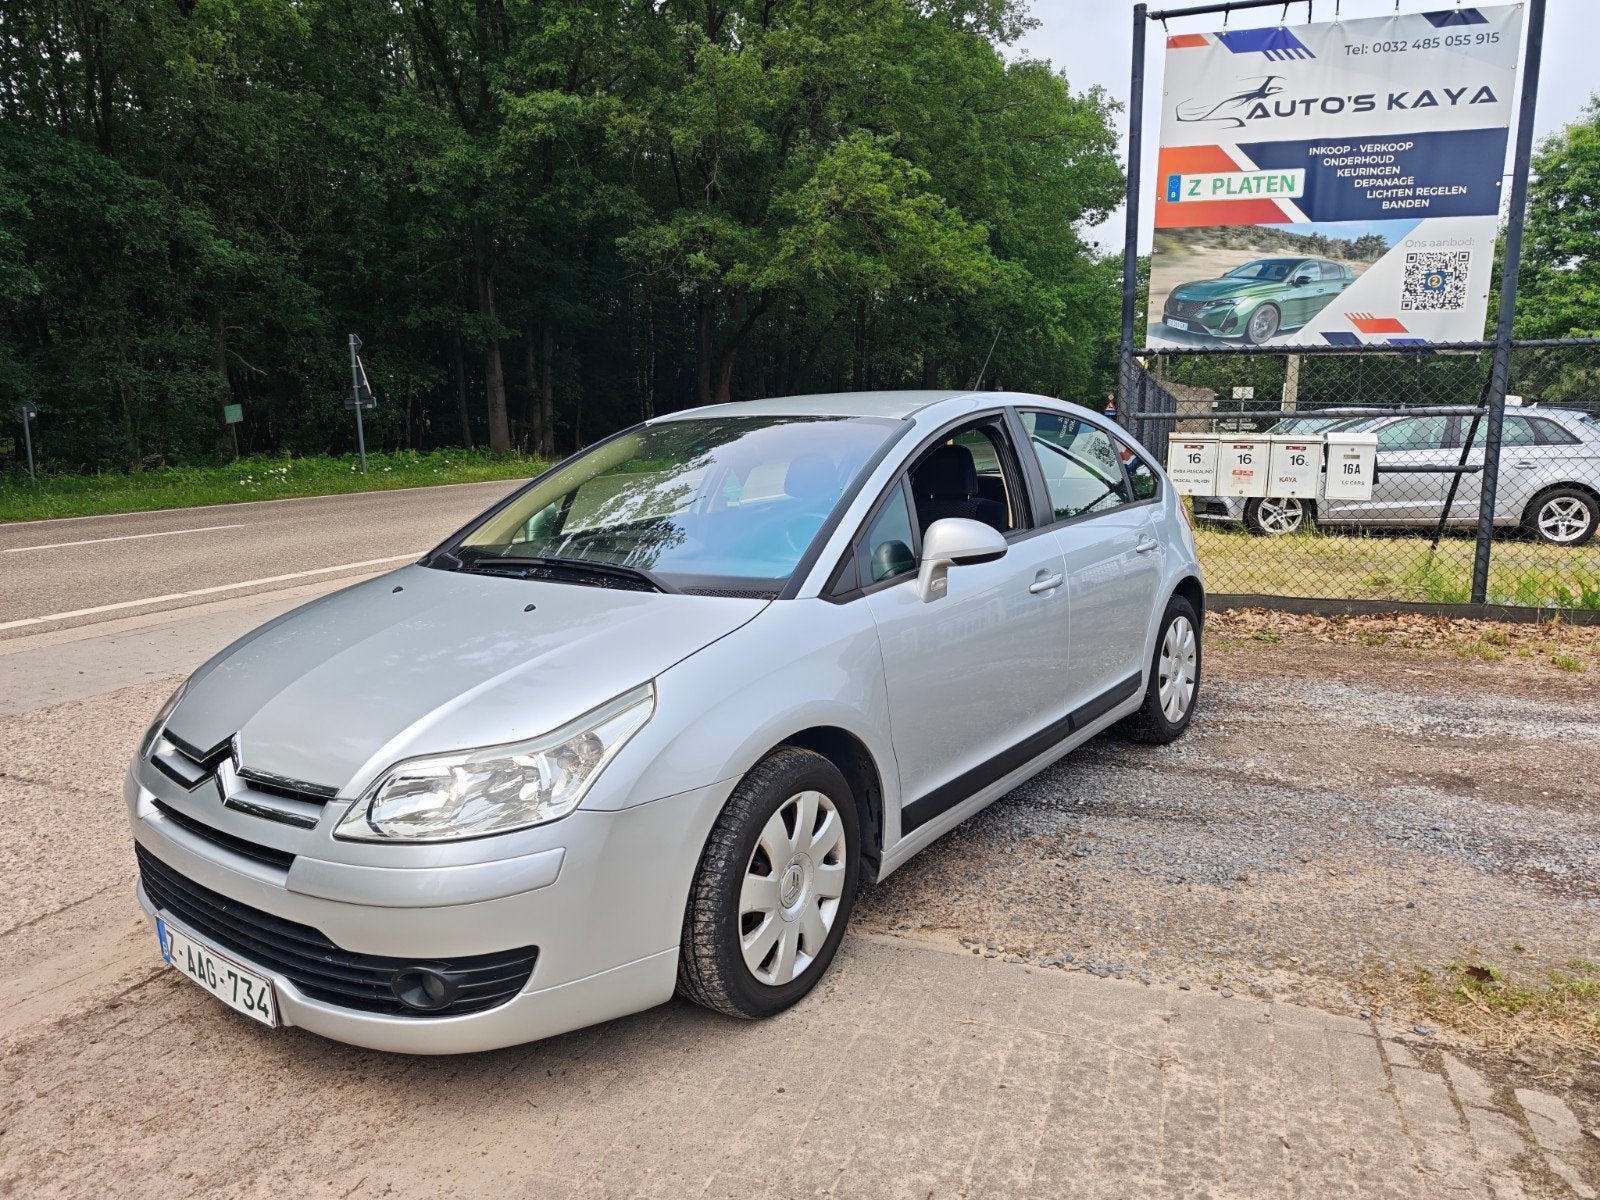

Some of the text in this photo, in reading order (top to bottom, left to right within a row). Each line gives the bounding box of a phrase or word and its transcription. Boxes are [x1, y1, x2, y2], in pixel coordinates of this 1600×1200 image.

[1345, 32, 1500, 56] Tel: 0032 485 055 915
[1246, 86, 1498, 119] AUTO'S KAYA
[1309, 145, 1351, 156] INKOOP
[1360, 142, 1414, 153] VERKOOP
[1323, 155, 1394, 166] ONDERHOUD
[1337, 166, 1401, 177] KEURINGEN
[1188, 174, 1296, 196] Z PLATEN
[1354, 176, 1415, 188] DEPANAGE
[1366, 185, 1468, 199] LICHTEN REGELEN
[1382, 199, 1430, 210] BANDEN
[1405, 237, 1475, 248] Ons aanbod:
[1187, 453, 1202, 464] 16
[1237, 454, 1252, 465] 16
[1343, 463, 1361, 475] 16A
[166, 931, 269, 1018] Z-AAG-734
